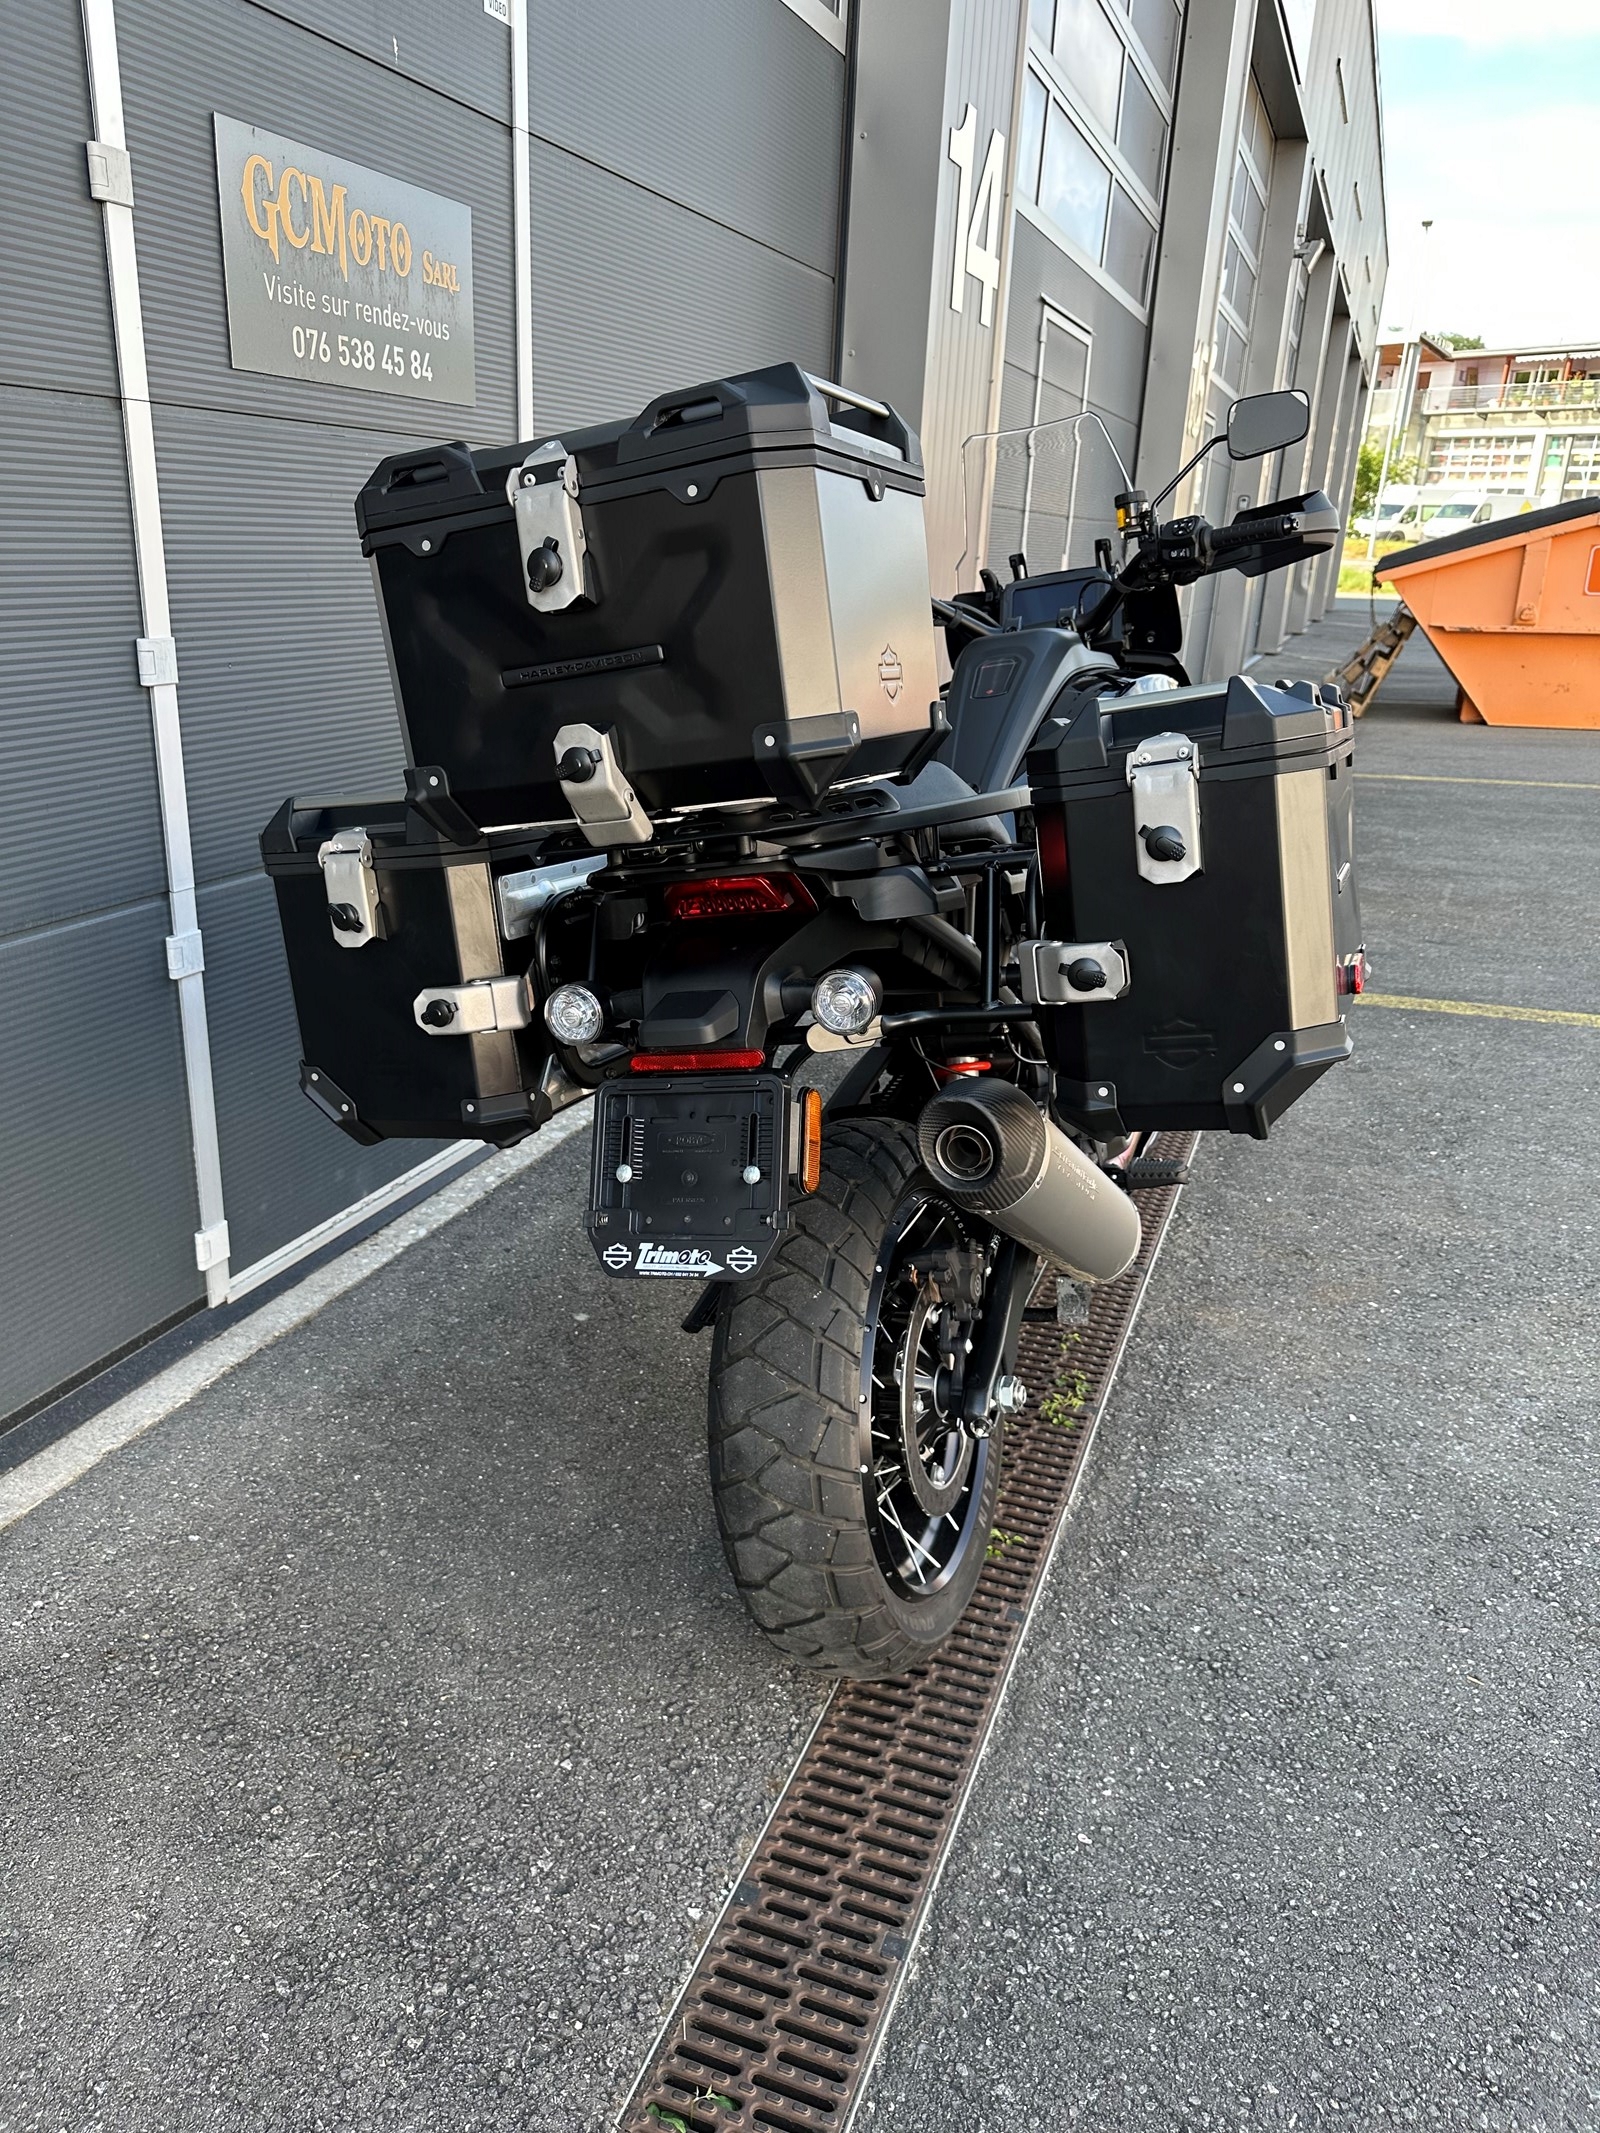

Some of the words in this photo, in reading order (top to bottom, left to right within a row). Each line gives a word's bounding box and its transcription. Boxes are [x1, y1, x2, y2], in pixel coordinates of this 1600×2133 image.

[948, 102, 1006, 328] 14
[263, 272, 316, 310] Visite
[321, 294, 350, 317] sur
[355, 302, 450, 341] rendez-vous
[292, 326, 331, 364] 076
[338, 335, 375, 371] 538
[381, 344, 405, 377] 45
[410, 350, 433, 382] 84
[978, 1440, 998, 1529] HELIN
